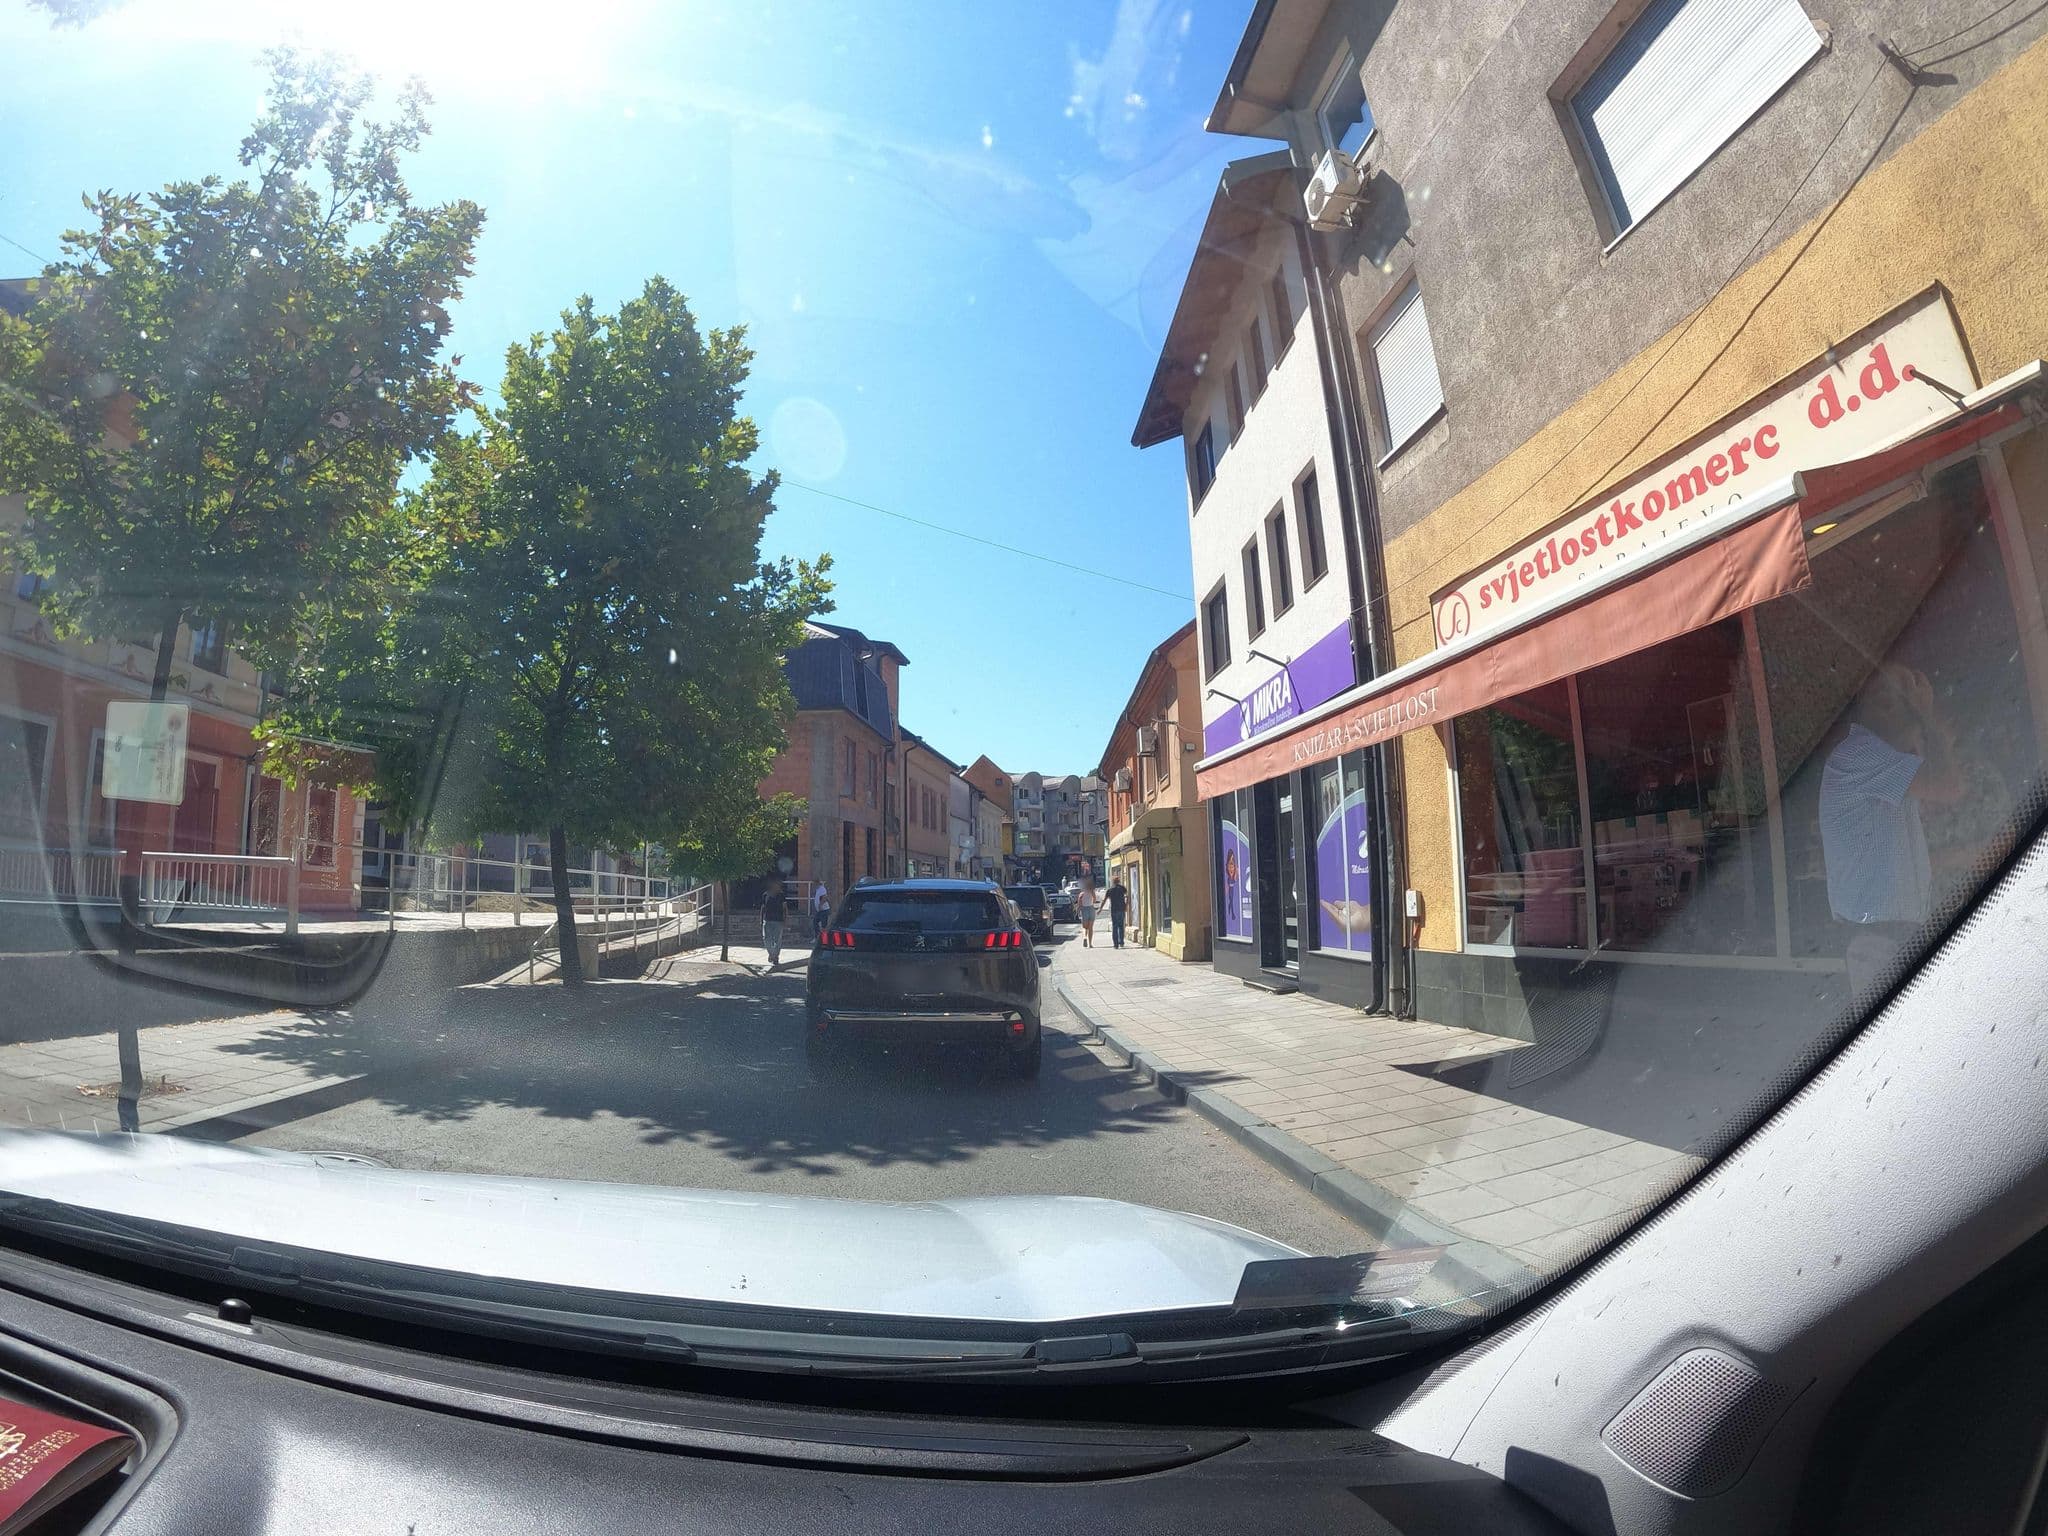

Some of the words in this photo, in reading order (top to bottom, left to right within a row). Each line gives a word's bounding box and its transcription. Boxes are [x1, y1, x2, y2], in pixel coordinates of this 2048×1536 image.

[1480, 424, 1780, 609] svjetlostkomerc
[1808, 342, 1916, 428] d.d.
[1253, 670, 1291, 726] MIKRA
[1294, 724, 1352, 762] KNJIŽARA
[1353, 687, 1439, 740] SVJETLOST
